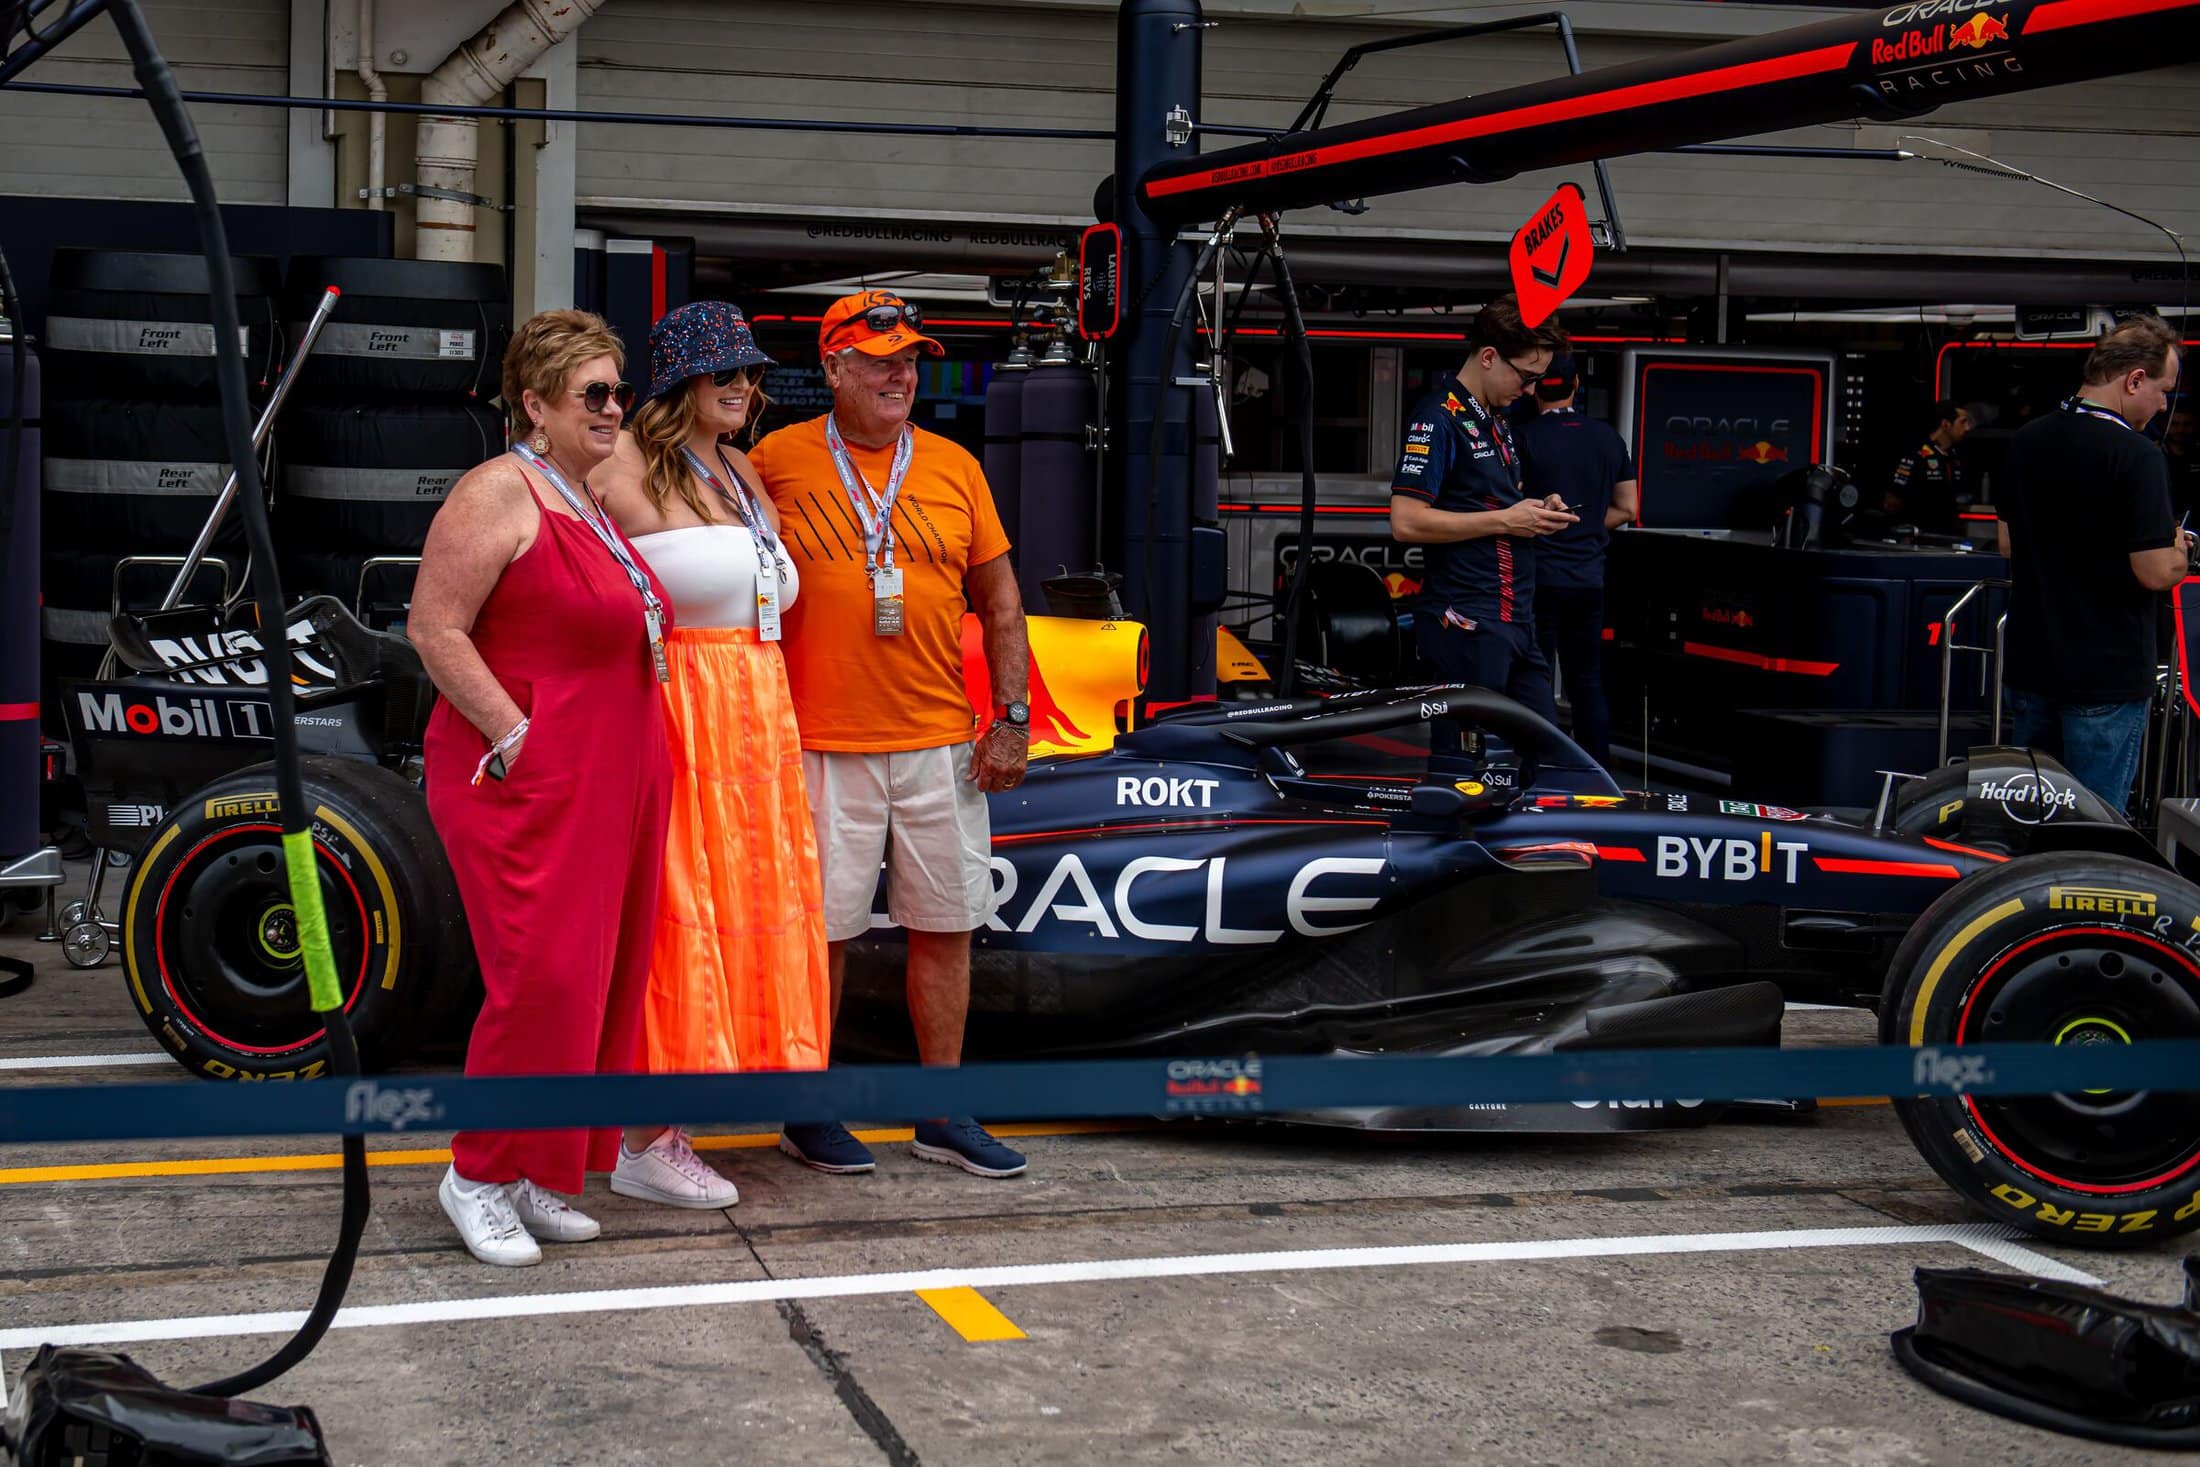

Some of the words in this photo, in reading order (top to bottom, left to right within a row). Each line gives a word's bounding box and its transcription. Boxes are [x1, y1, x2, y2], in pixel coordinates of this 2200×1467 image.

[1880, 57, 2024, 95] RACING
[807, 223, 953, 243] @REDBULLRACING
[1523, 202, 1564, 257] BRAKES
[1083, 267, 1093, 301] REVS
[1107, 253, 1117, 306] LAUNCH
[139, 339, 169, 348] Left
[141, 328, 182, 339] Front
[370, 332, 410, 342] Front
[368, 342, 398, 351] Left
[1468, 396, 1486, 420] zoom
[1411, 422, 1434, 432] Mobil
[158, 478, 189, 488] Left
[160, 468, 195, 478] Rear
[418, 476, 449, 485] Rear
[416, 486, 444, 495] Left
[908, 493, 928, 522] WORLD
[926, 522, 948, 564] CHAMPION
[78, 692, 222, 738] Mobil
[240, 704, 260, 736] 1
[1433, 701, 1448, 716] Sui
[1117, 777, 1220, 808] ROKT
[1495, 775, 1512, 786] Sui
[205, 792, 280, 819] PIRELL
[1374, 793, 1412, 801] POKERSTA
[1980, 782, 2029, 803] Hard
[2030, 786, 2076, 810] Rock
[1939, 800, 1964, 824] P
[1656, 831, 1808, 884] BYBIT
[872, 853, 1388, 945] RACLE
[2049, 887, 2157, 917] PIRELLI
[1167, 1060, 1262, 1080] ORACLE
[1990, 1184, 2158, 1233] ZERO
